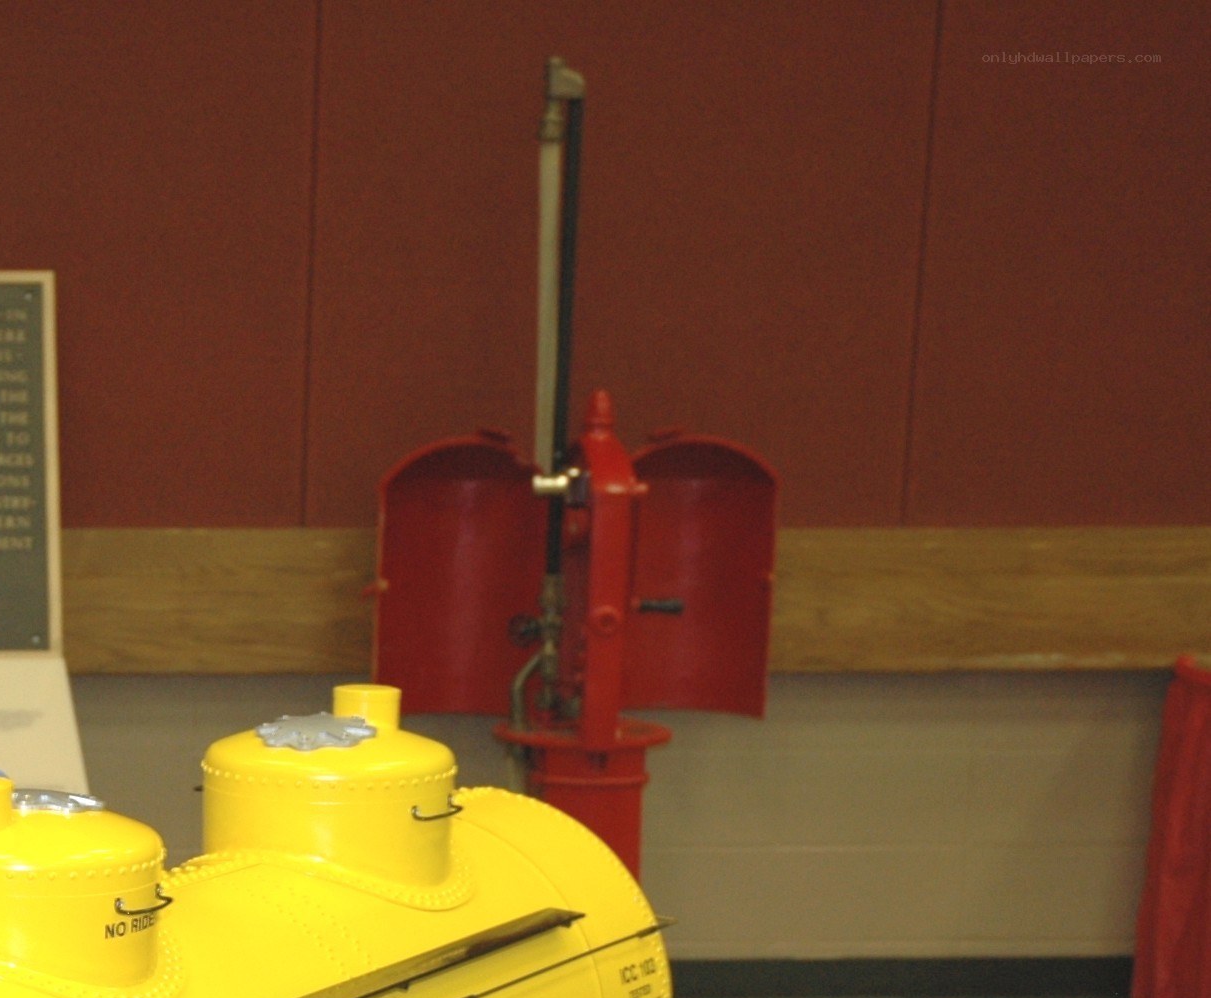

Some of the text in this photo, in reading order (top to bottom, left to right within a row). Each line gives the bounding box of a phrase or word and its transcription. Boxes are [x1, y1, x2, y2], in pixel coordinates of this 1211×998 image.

[0, 389, 28, 404] THE
[0, 411, 28, 424] THE
[5, 431, 30, 446] TO
[105, 921, 126, 939] NO
